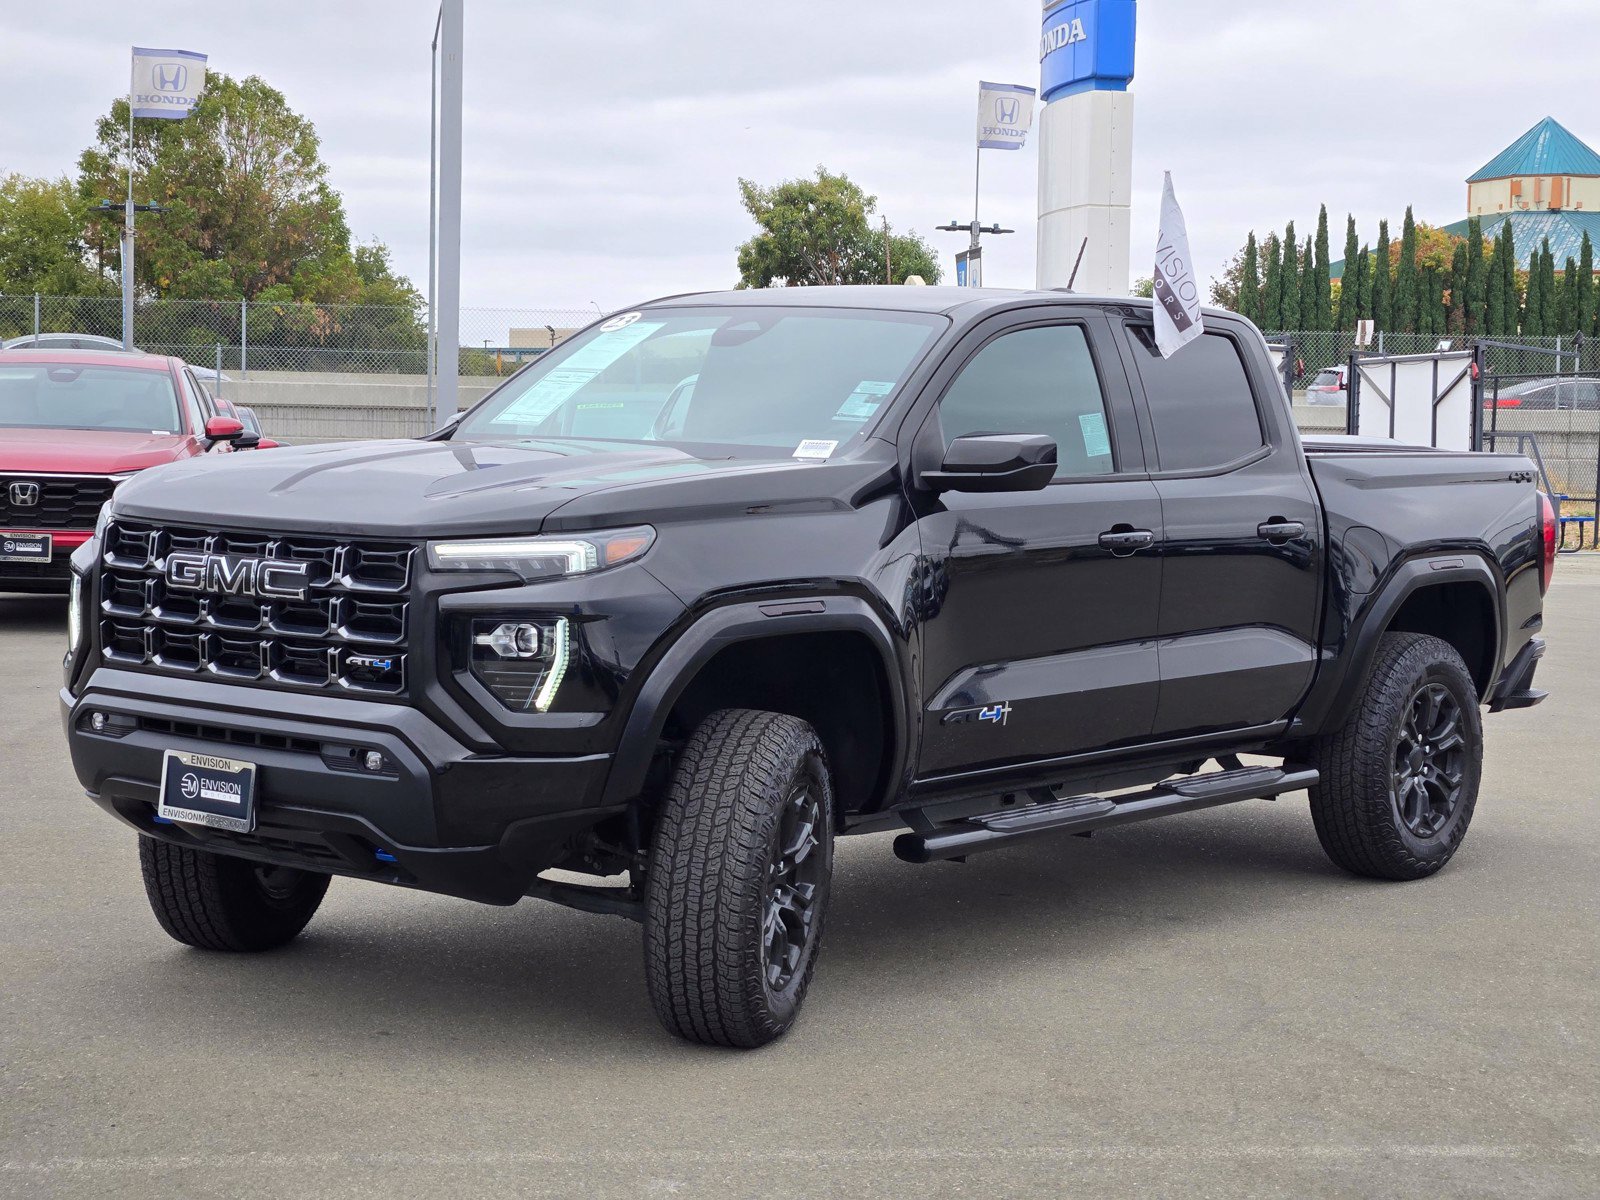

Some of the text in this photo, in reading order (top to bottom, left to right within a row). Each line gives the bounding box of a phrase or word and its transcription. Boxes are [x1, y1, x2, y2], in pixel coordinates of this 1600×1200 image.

[1040, 18, 1087, 63] ONDA
[165, 553, 308, 601] GMC
[345, 656, 391, 671] AT4
[190, 754, 231, 770] ENVISION
[201, 778, 241, 794] ENVISION
